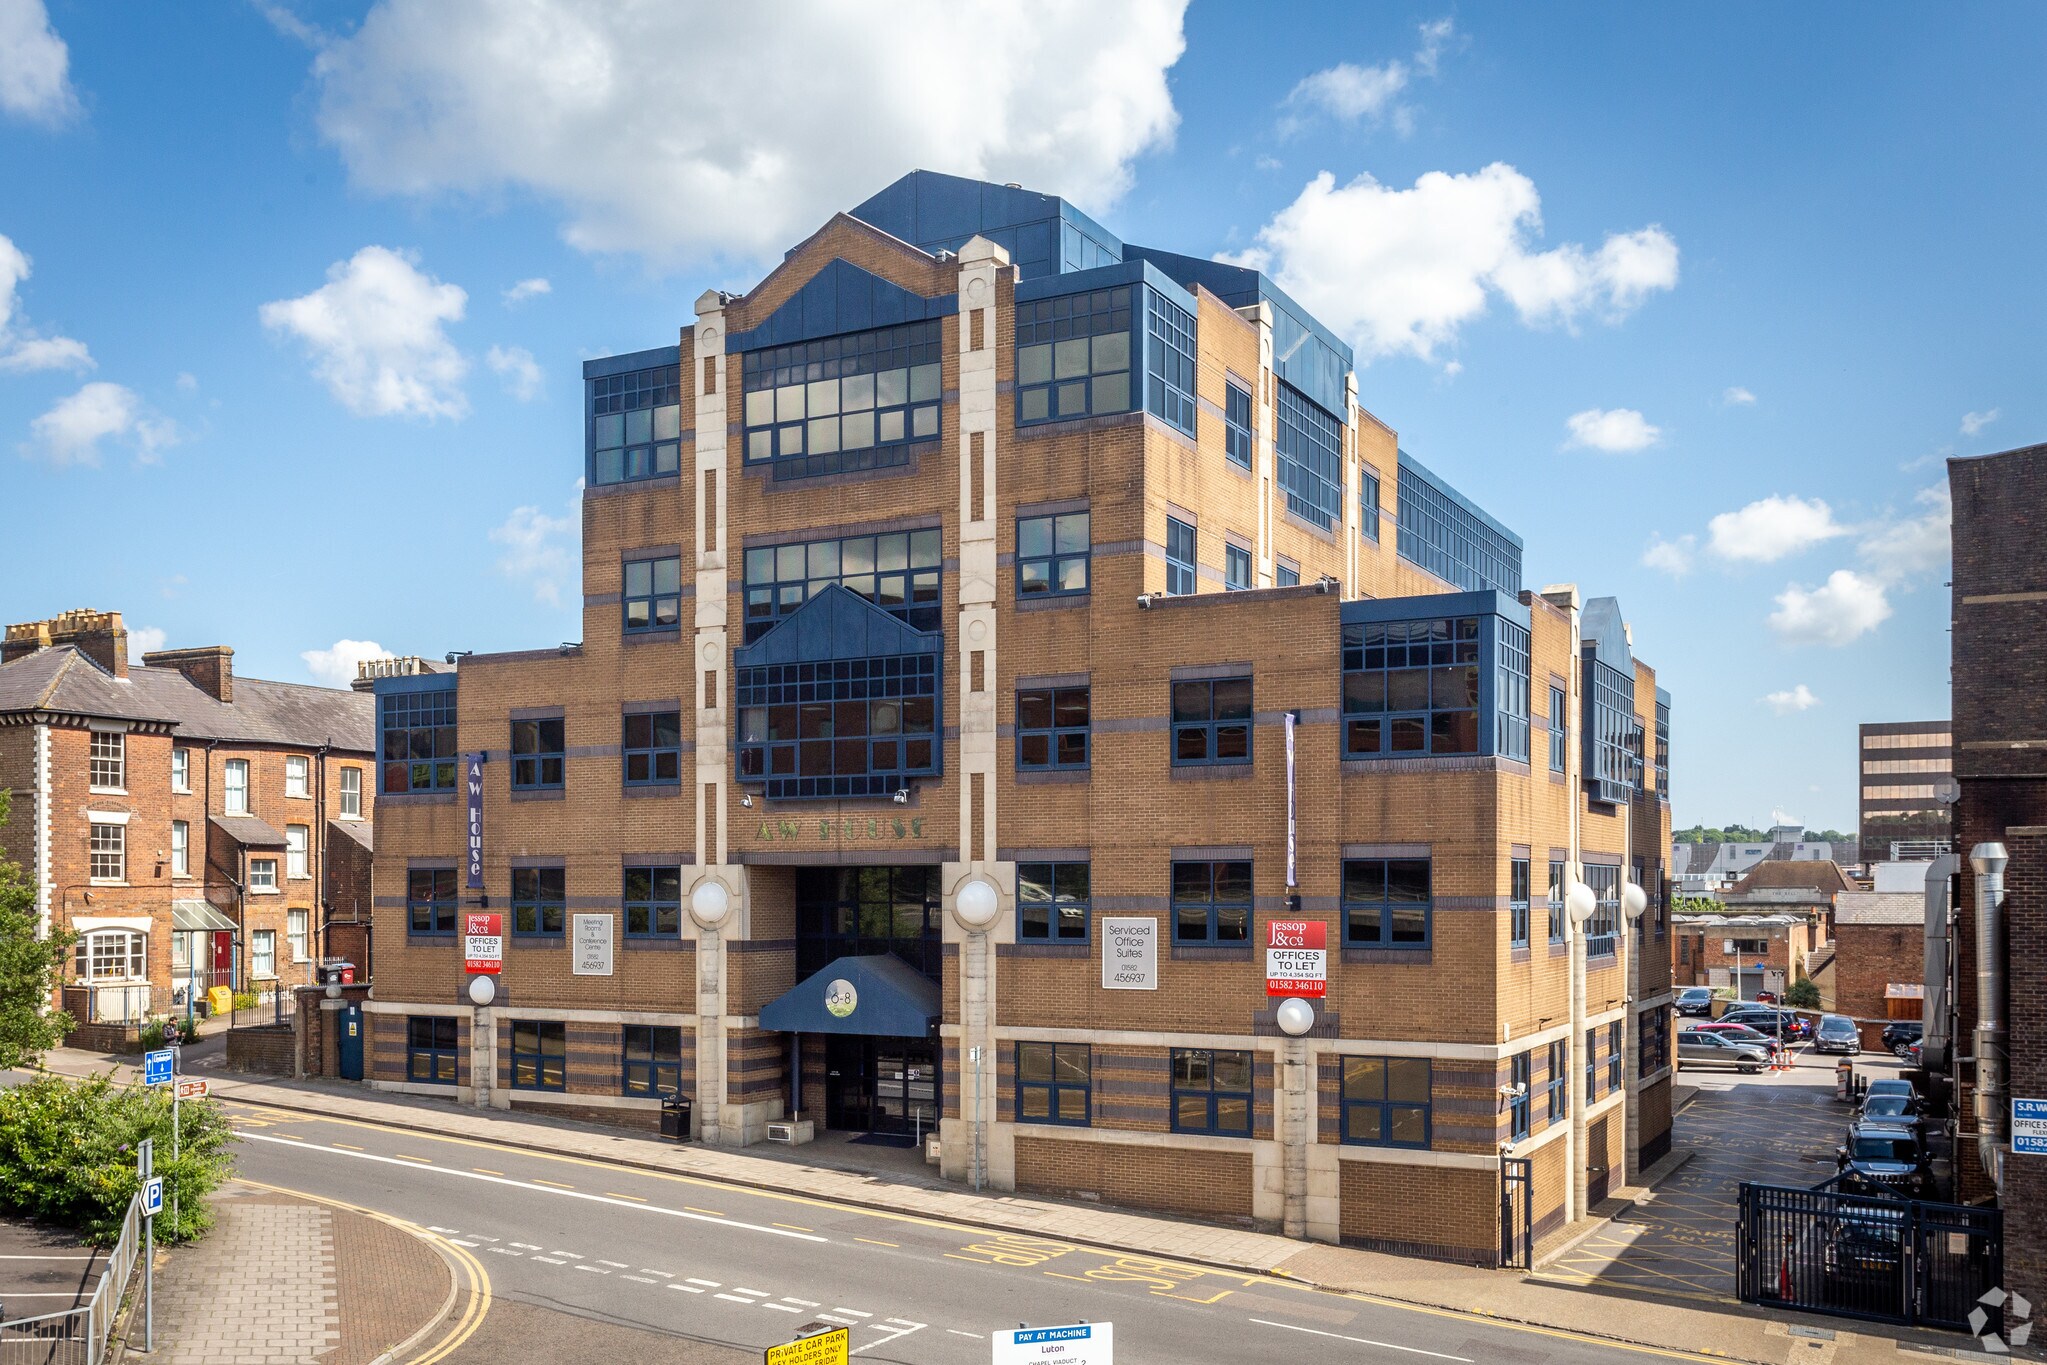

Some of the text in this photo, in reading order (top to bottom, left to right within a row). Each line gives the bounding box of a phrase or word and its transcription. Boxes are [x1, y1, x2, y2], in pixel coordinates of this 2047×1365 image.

[755, 816, 929, 841] AW HOUSE
[467, 915, 491, 934] Jessop
[582, 918, 604, 927] Meeting
[1109, 925, 1150, 935] Serviced
[1269, 921, 1307, 946] Jessop
[469, 937, 499, 945] OFFICES
[578, 937, 608, 945] Conference
[1114, 936, 1145, 947] Office
[472, 945, 496, 953] TO LET
[1116, 947, 1143, 958] Suites
[1273, 951, 1320, 961] OFFICES
[466, 960, 482, 968] 01582
[581, 961, 605, 970] 456937
[1278, 961, 1316, 971] TO LET
[1114, 973, 1146, 983] 456937
[1269, 980, 1324, 991] 01582 346110
[831, 992, 851, 1004] 6-8
[2014, 1119, 2041, 1129] OFFICE
[149, 1184, 160, 1208] P
[1672, 1227, 1737, 1240] PARK
[1018, 1328, 1087, 1342] PAY AT MACHINE
[805, 1338, 823, 1351] CAR
[825, 1332, 846, 1345] PARK
[789, 1349, 822, 1365] HOLDERS
[824, 1344, 842, 1356] ONLY
[1041, 1345, 1065, 1354] Luton
[814, 1354, 838, 1365] FRIDAY
[1053, 1357, 1078, 1365] VIADUCT
